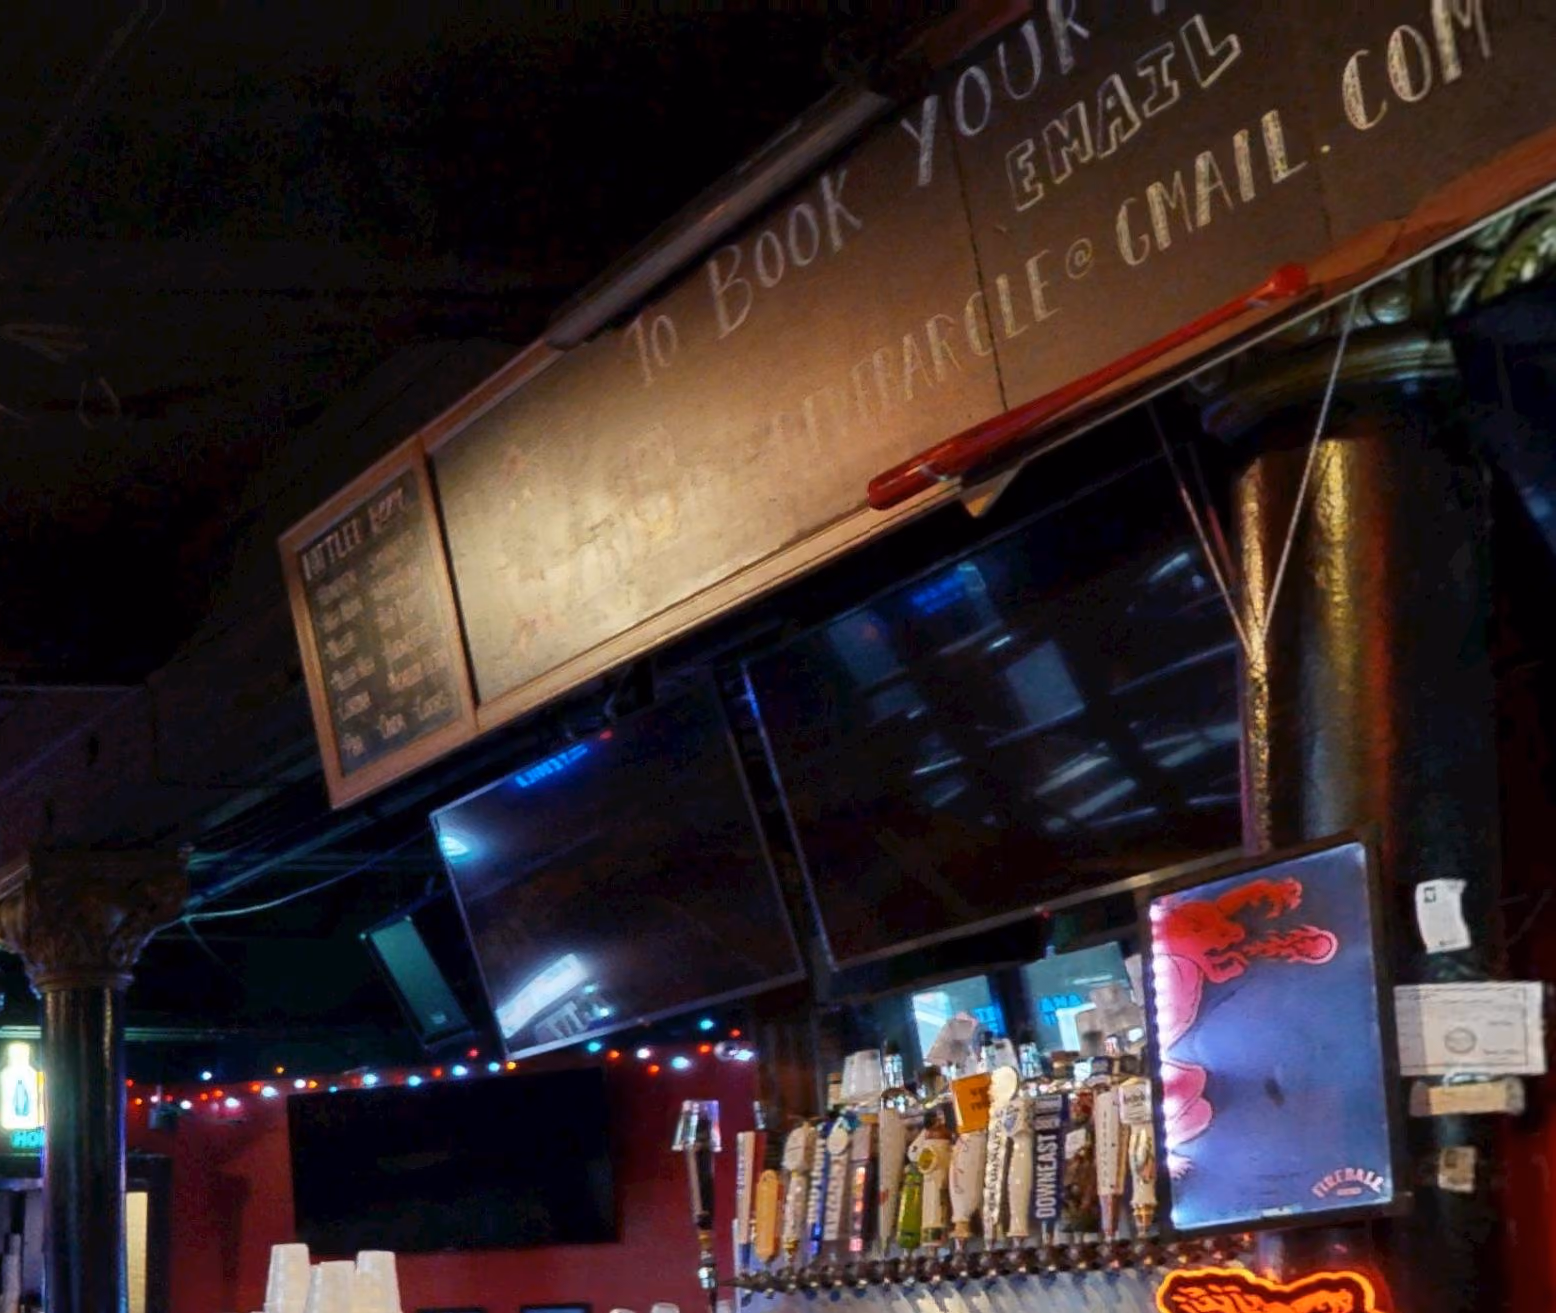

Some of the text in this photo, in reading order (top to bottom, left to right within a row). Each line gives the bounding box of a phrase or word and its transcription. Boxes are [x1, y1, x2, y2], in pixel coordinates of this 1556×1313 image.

[705, 168, 863, 340] BOOK
[899, 0, 1090, 186] YOUR
[1005, 14, 1242, 212] EMAIL
[1035, 1132, 1057, 1219] DOWNEAST
[1311, 1167, 1384, 1198] FIREBALL
